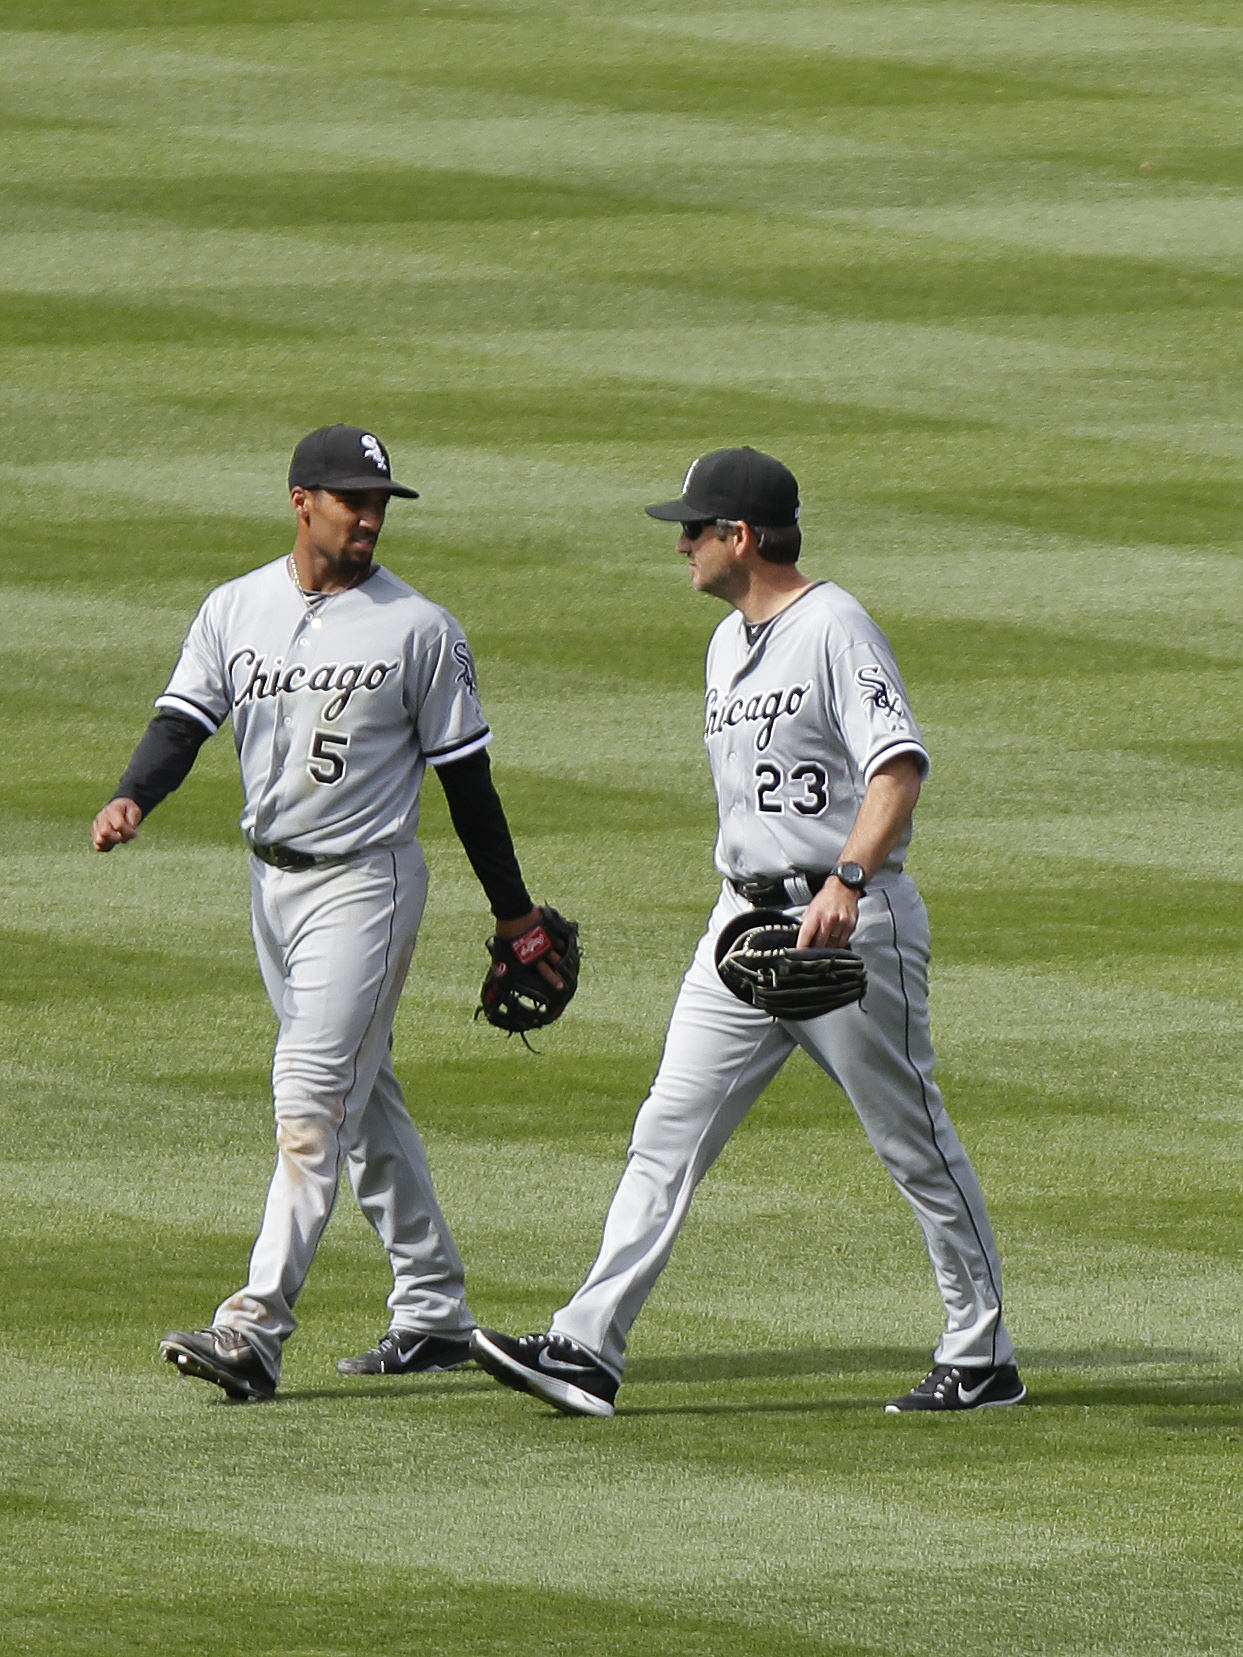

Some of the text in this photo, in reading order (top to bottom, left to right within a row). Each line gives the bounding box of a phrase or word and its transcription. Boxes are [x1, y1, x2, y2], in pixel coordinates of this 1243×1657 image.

[227, 646, 402, 723] Chicago
[855, 663, 904, 718] Sox
[307, 728, 351, 787] 5
[754, 758, 830, 817] 23
